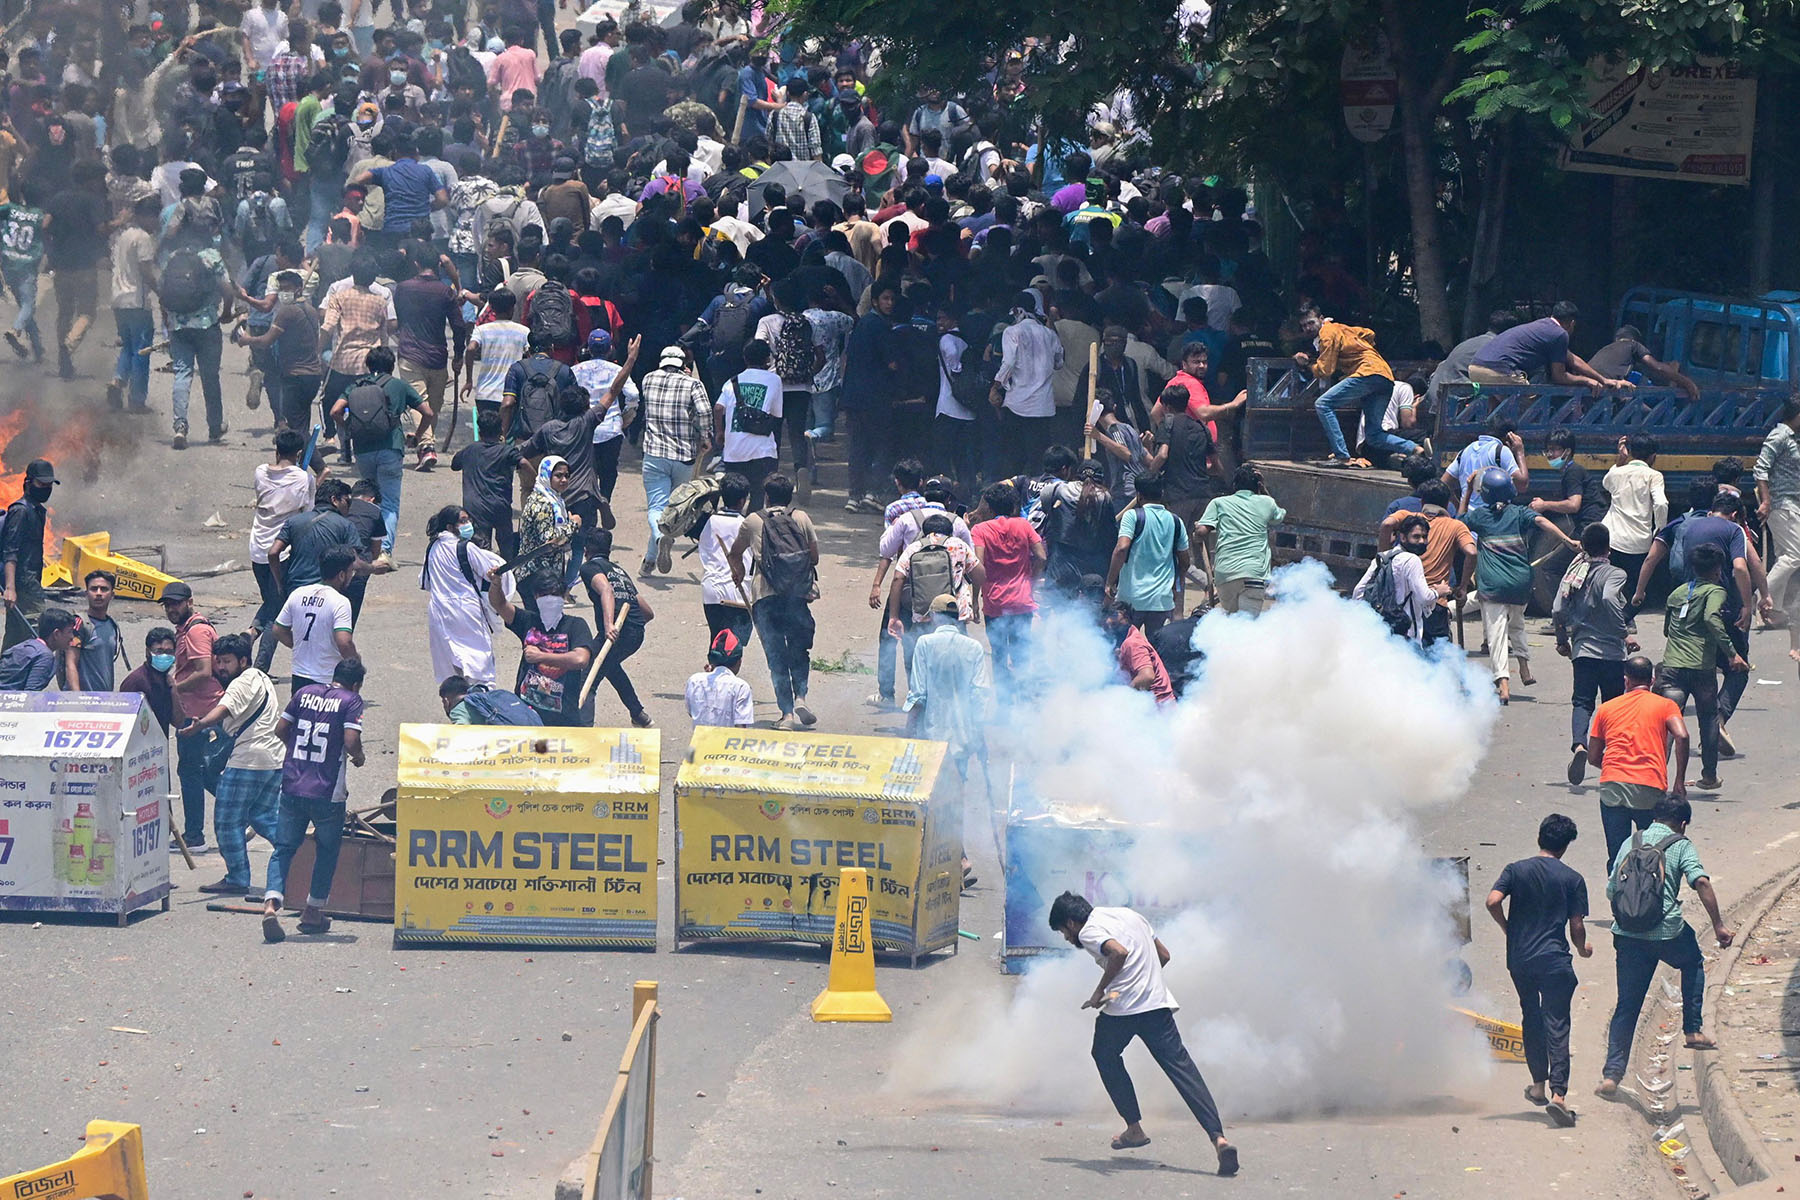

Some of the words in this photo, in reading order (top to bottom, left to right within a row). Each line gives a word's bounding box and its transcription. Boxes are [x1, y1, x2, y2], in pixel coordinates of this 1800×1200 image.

[301, 595, 325, 608] RAFID
[303, 612, 317, 642] 7
[300, 693, 342, 713] SHOVON
[67, 721, 114, 730] HOTLINE
[44, 730, 123, 749] 16797
[292, 719, 330, 763] 25
[496, 738, 573, 755] STEL
[724, 737, 778, 753] RRM
[783, 741, 857, 759] STEEL
[517, 801, 539, 814] পুলিশ
[542, 803, 559, 812] চেক
[561, 803, 585, 814] পোস্ট
[612, 801, 648, 812] RRM
[789, 803, 811, 816] পুলিশ
[814, 806, 830, 816] চেক
[832, 808, 856, 818] পোস্ট
[881, 808, 916, 820] RRM
[132, 818, 161, 858] 16797
[408, 829, 503, 869] RRM
[512, 832, 648, 873] STEEL
[710, 834, 781, 864] RRM
[790, 838, 893, 872] STEEL
[414, 876, 459, 890] দেশের
[463, 877, 518, 892] সবচেয়ে
[523, 875, 597, 893] শক্তিশালী
[604, 877, 641, 894] স্টিল
[687, 872, 734, 886] দেশের
[880, 877, 911, 899] স্টিল
[845, 895, 868, 954] বিজলী
